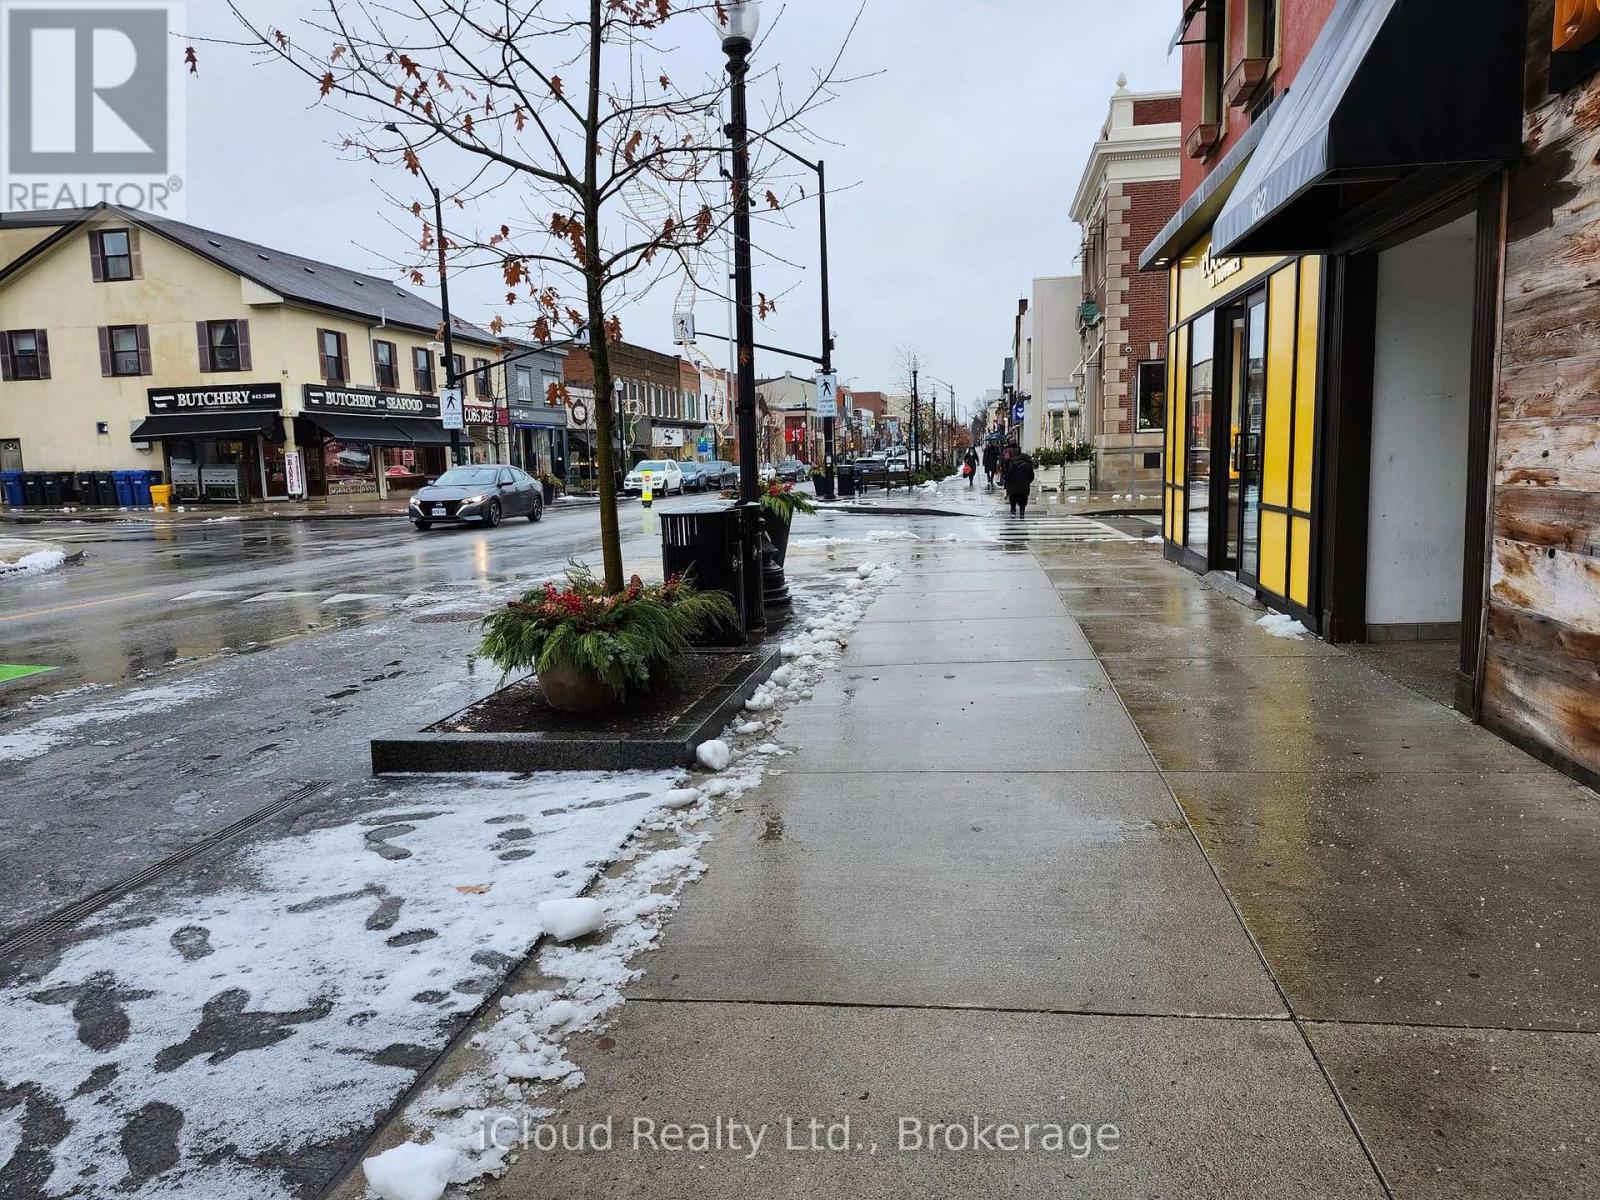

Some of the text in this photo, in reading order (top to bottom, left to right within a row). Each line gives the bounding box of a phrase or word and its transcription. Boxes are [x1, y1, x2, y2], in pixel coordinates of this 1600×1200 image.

[177, 391, 250, 407] BUTCHERY
[325, 391, 377, 408] BUTCHERY
[386, 396, 423, 411] SEAFOOD
